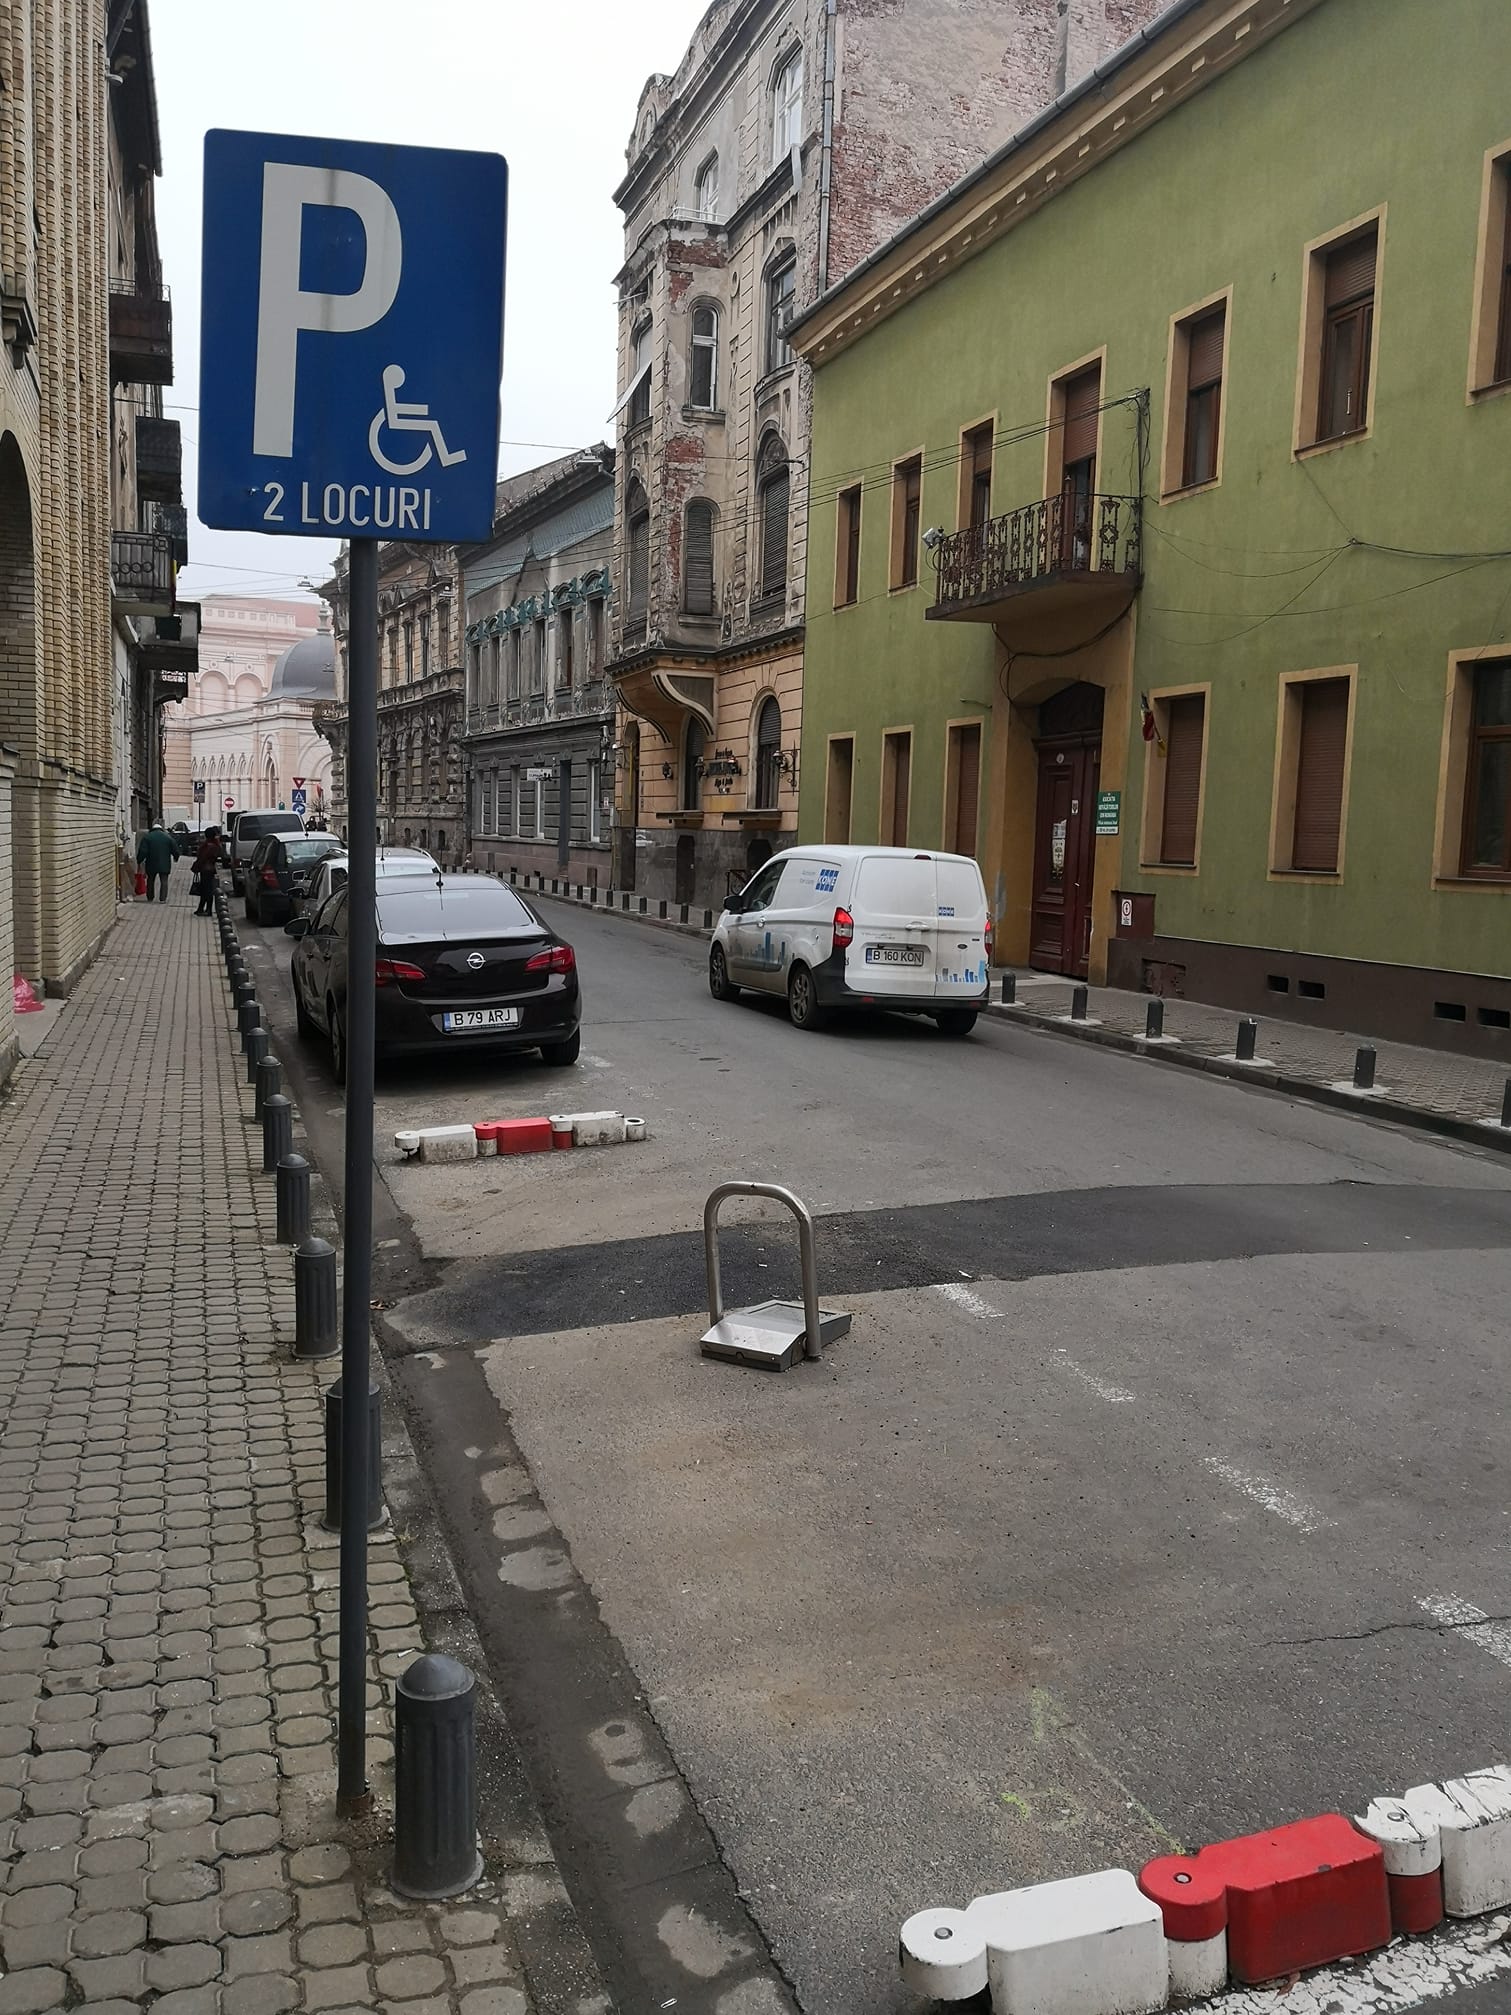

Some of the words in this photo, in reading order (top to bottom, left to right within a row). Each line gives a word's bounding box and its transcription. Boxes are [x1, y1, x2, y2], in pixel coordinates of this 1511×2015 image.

[253, 162, 402, 457] P
[262, 482, 285, 522] 2
[301, 481, 431, 530] LOCURI
[873, 950, 881, 961] B
[884, 950, 899, 961] 160
[900, 951, 922, 962] KON
[454, 1013, 464, 1026] B
[467, 1011, 483, 1024] 79
[488, 1009, 511, 1022] ARJ
